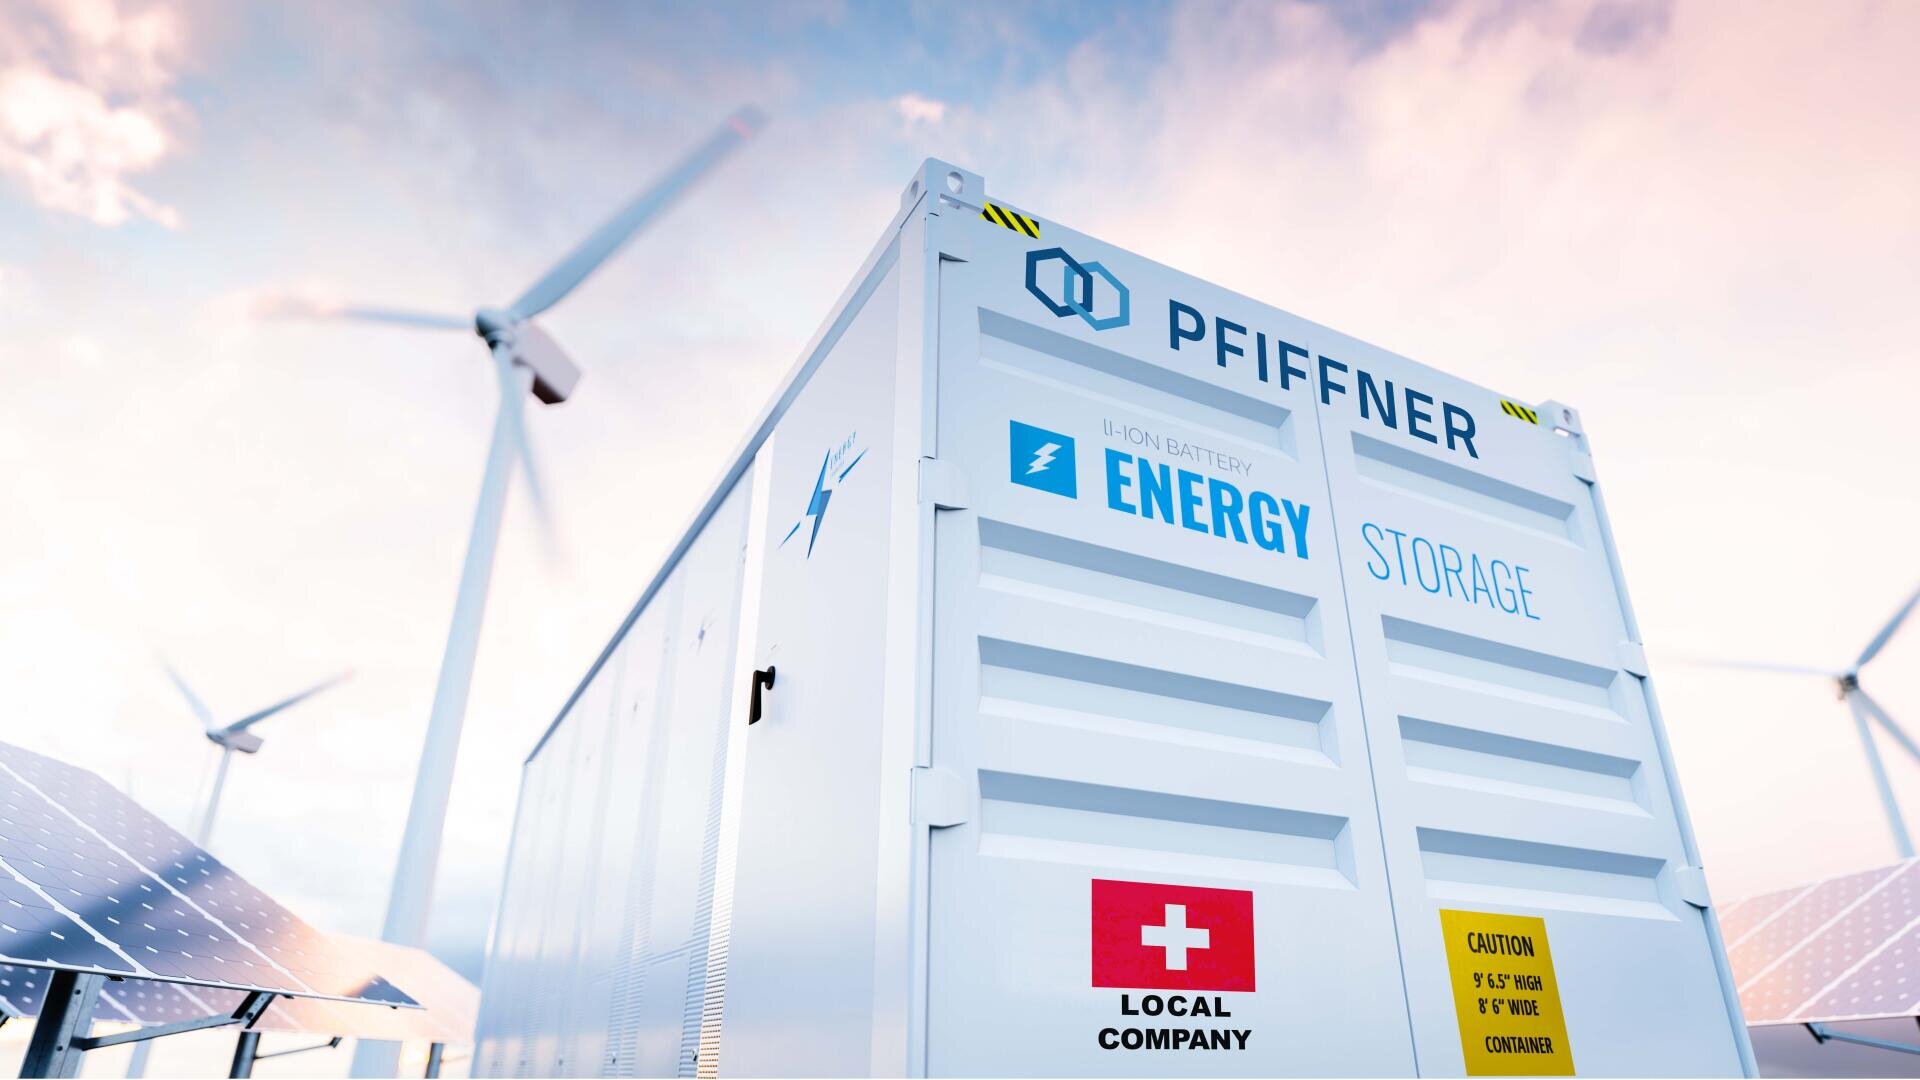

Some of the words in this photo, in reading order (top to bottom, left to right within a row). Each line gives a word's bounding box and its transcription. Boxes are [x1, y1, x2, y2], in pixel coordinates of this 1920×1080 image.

[1169, 299, 1479, 460] PFIFFNER
[1166, 437, 1253, 477] BATTERY
[1104, 447, 1311, 561] ENERGY
[1361, 522, 1541, 621] STORAGE
[1467, 931, 1535, 958] CAUTION
[1513, 974, 1543, 992] HIGH
[1121, 994, 1232, 1018] LOCAL
[1507, 998, 1540, 1017] WIDE
[1097, 1027, 1252, 1051] COMPANY
[1485, 1035, 1554, 1054] CONTAINER
